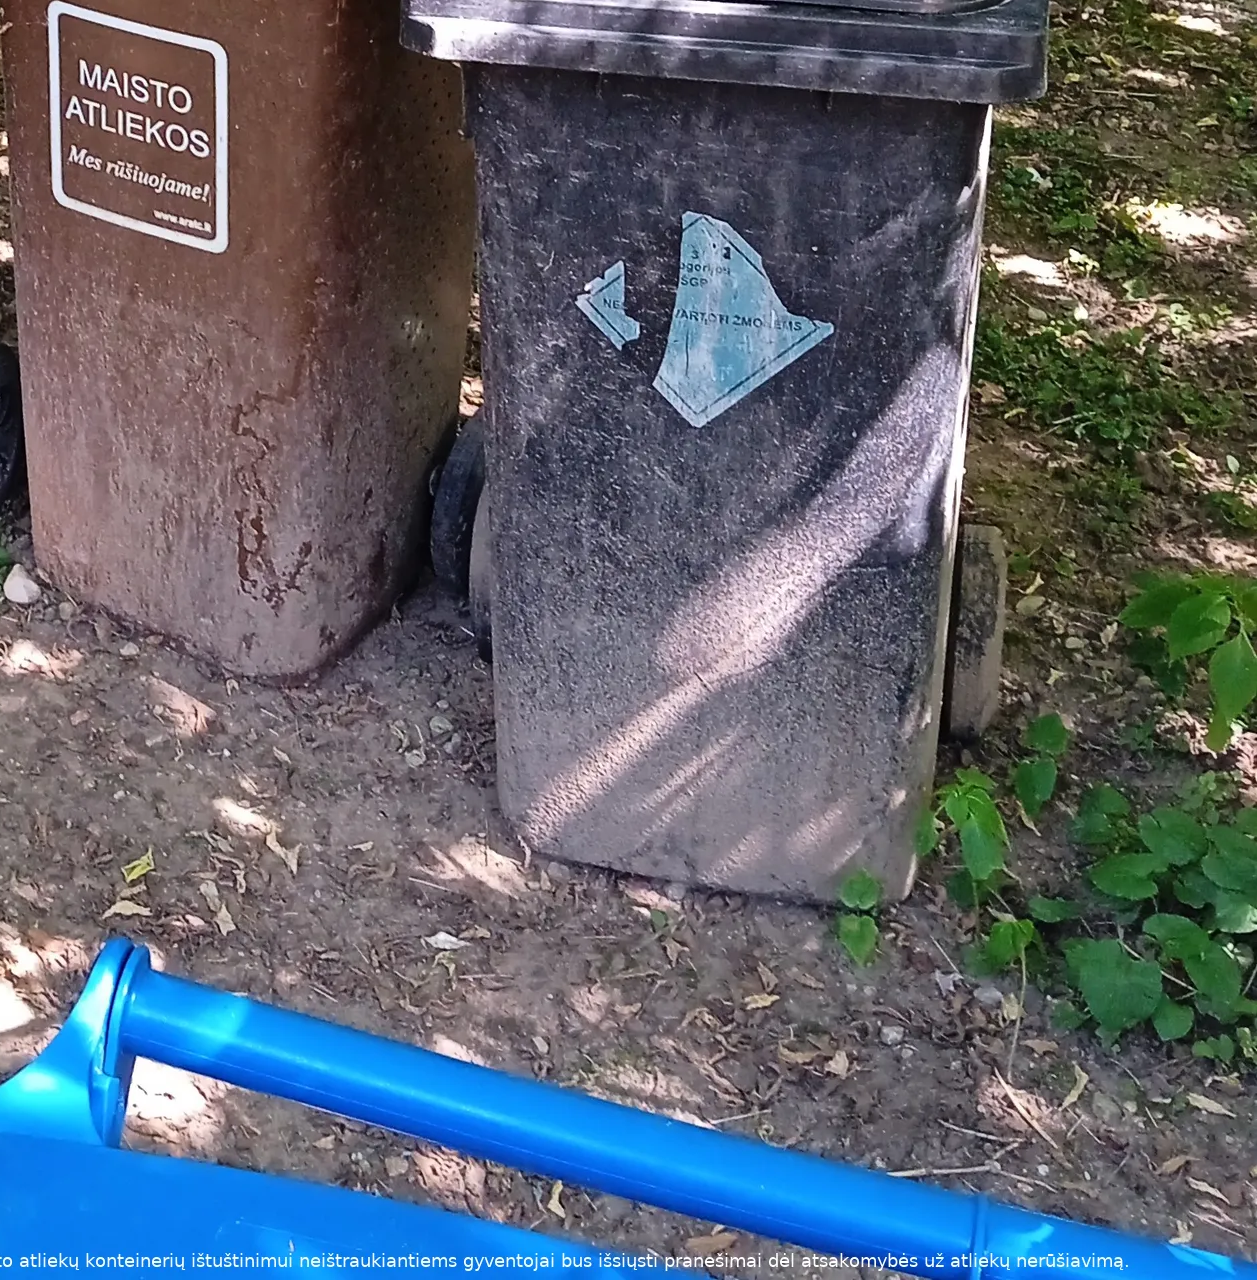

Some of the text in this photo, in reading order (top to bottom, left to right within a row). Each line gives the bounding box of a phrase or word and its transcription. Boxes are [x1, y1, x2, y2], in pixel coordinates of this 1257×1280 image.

[78, 58, 192, 114] MAISTO
[65, 95, 211, 158] ATLIEKOS
[68, 144, 210, 202] Mes rūšiuojame!
